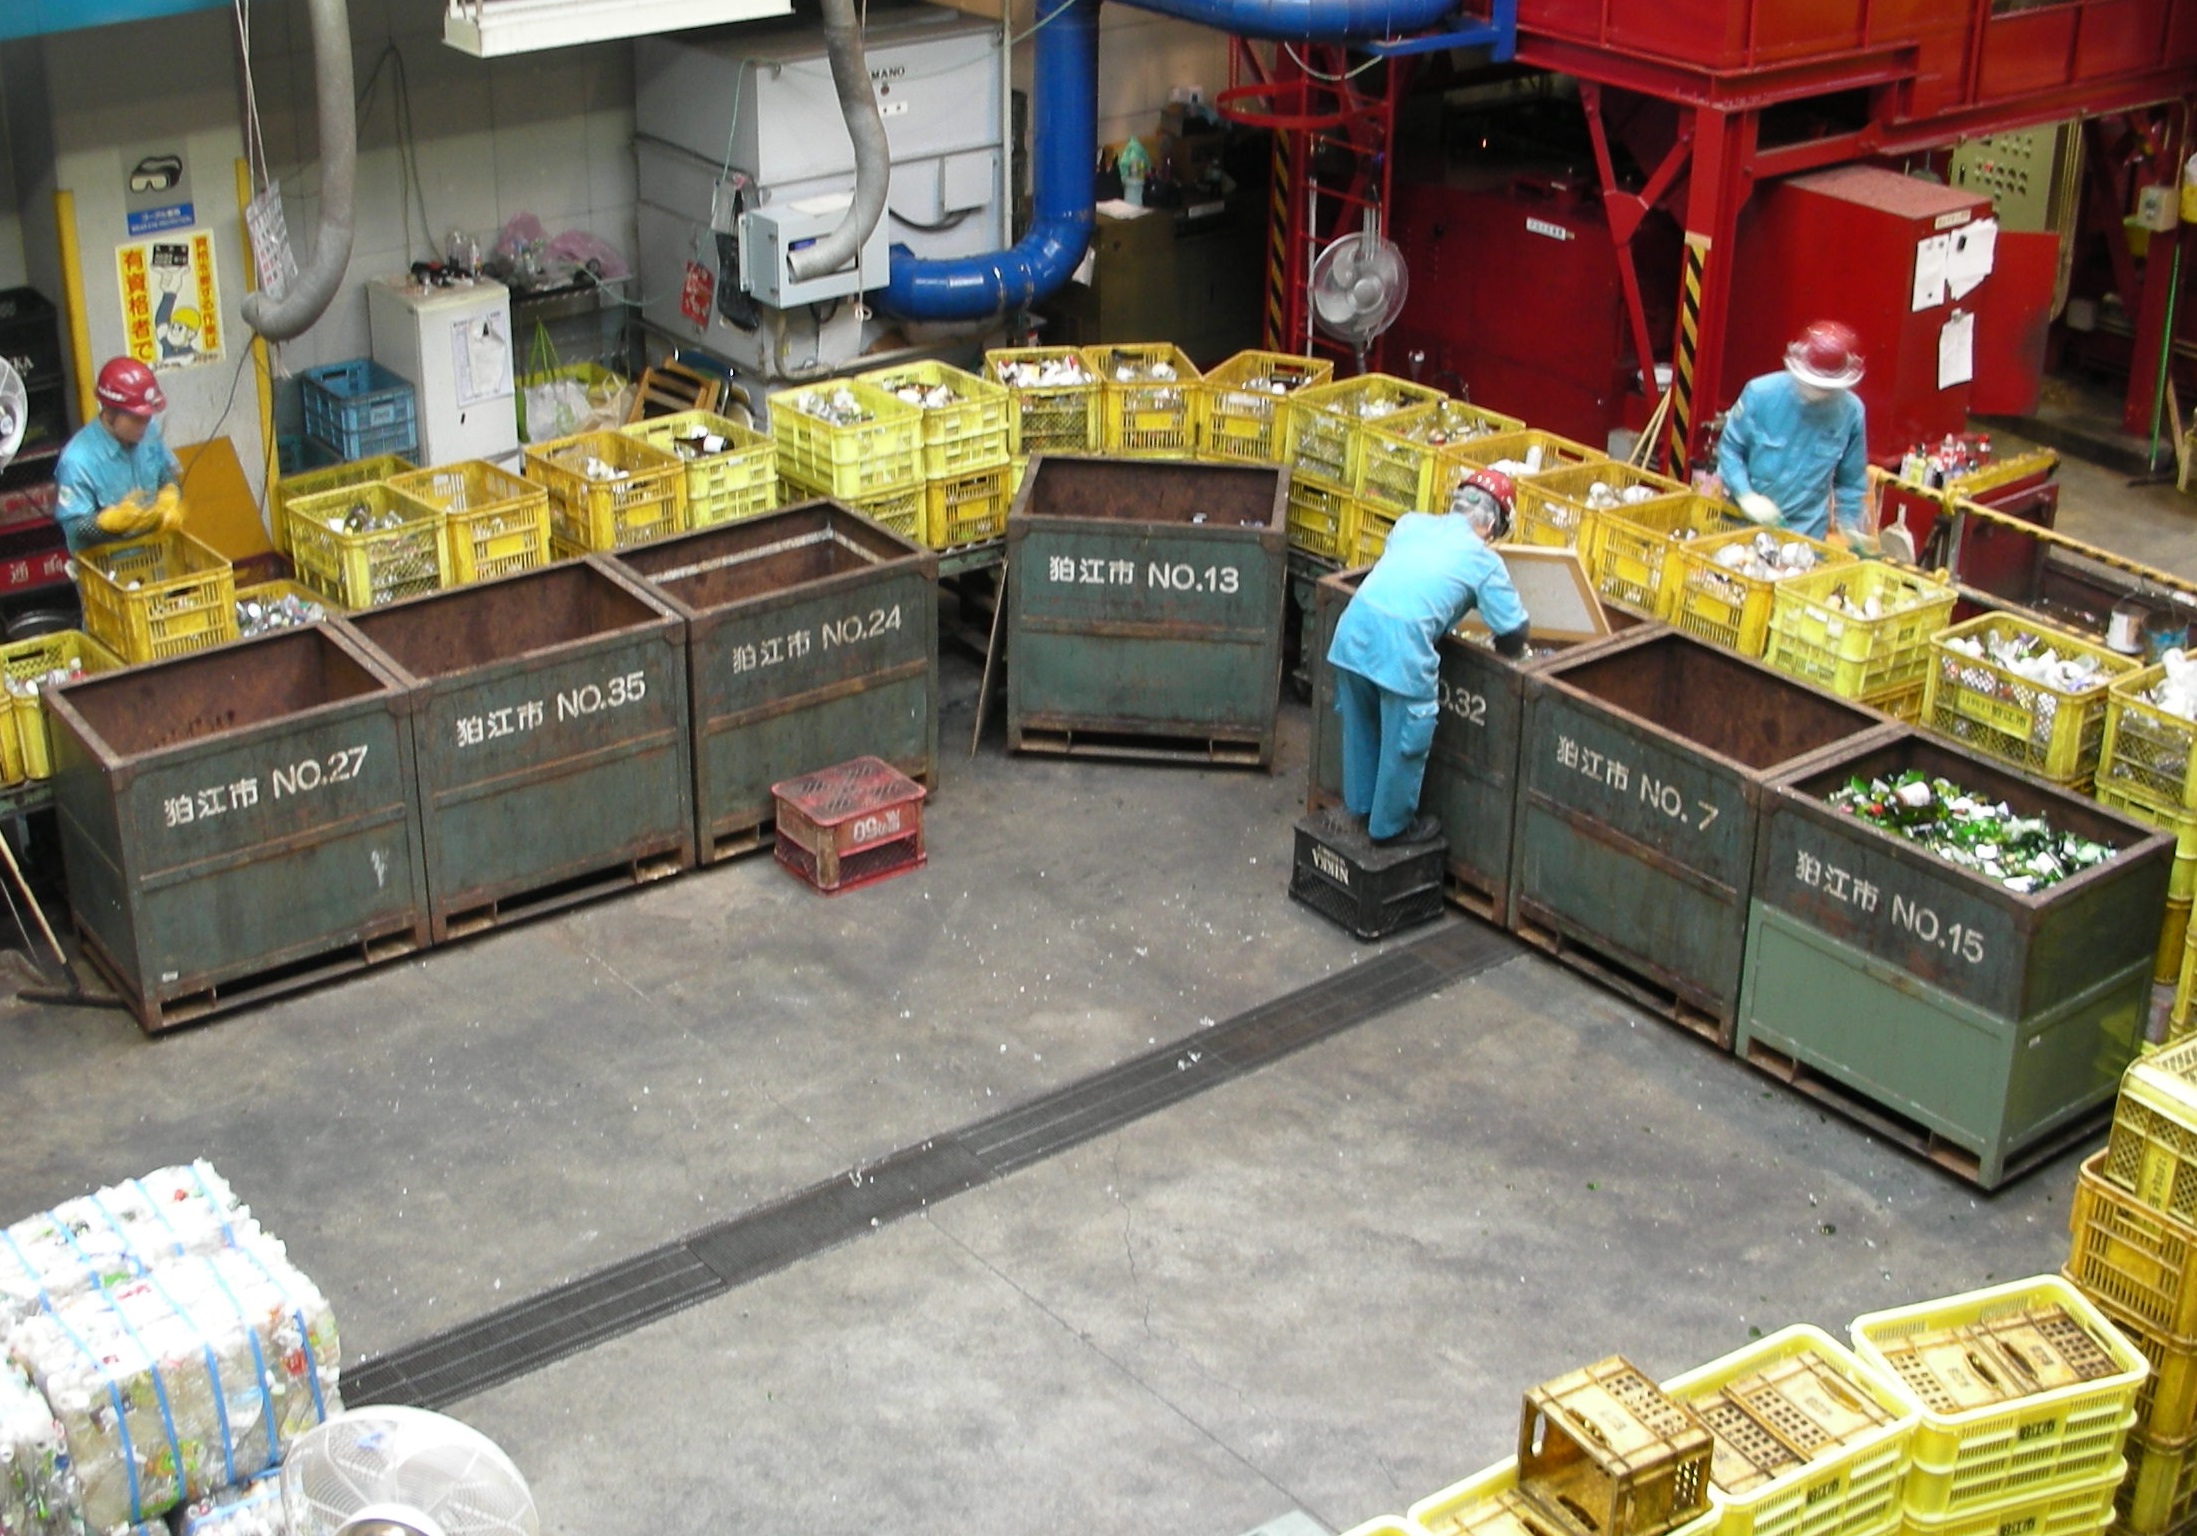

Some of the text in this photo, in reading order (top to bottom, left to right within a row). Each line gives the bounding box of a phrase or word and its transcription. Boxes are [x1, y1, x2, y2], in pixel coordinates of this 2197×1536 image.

[1049, 556, 1240, 594] 狛江市 NO.13
[732, 604, 902, 674] 狛江市 NO.24
[456, 670, 646, 748] 狛江市 NO.35
[164, 744, 368, 828] 狛江市 NO.27
[1556, 735, 1630, 792] 狛江市
[1795, 849, 1985, 964] 狛江市 NO.15
